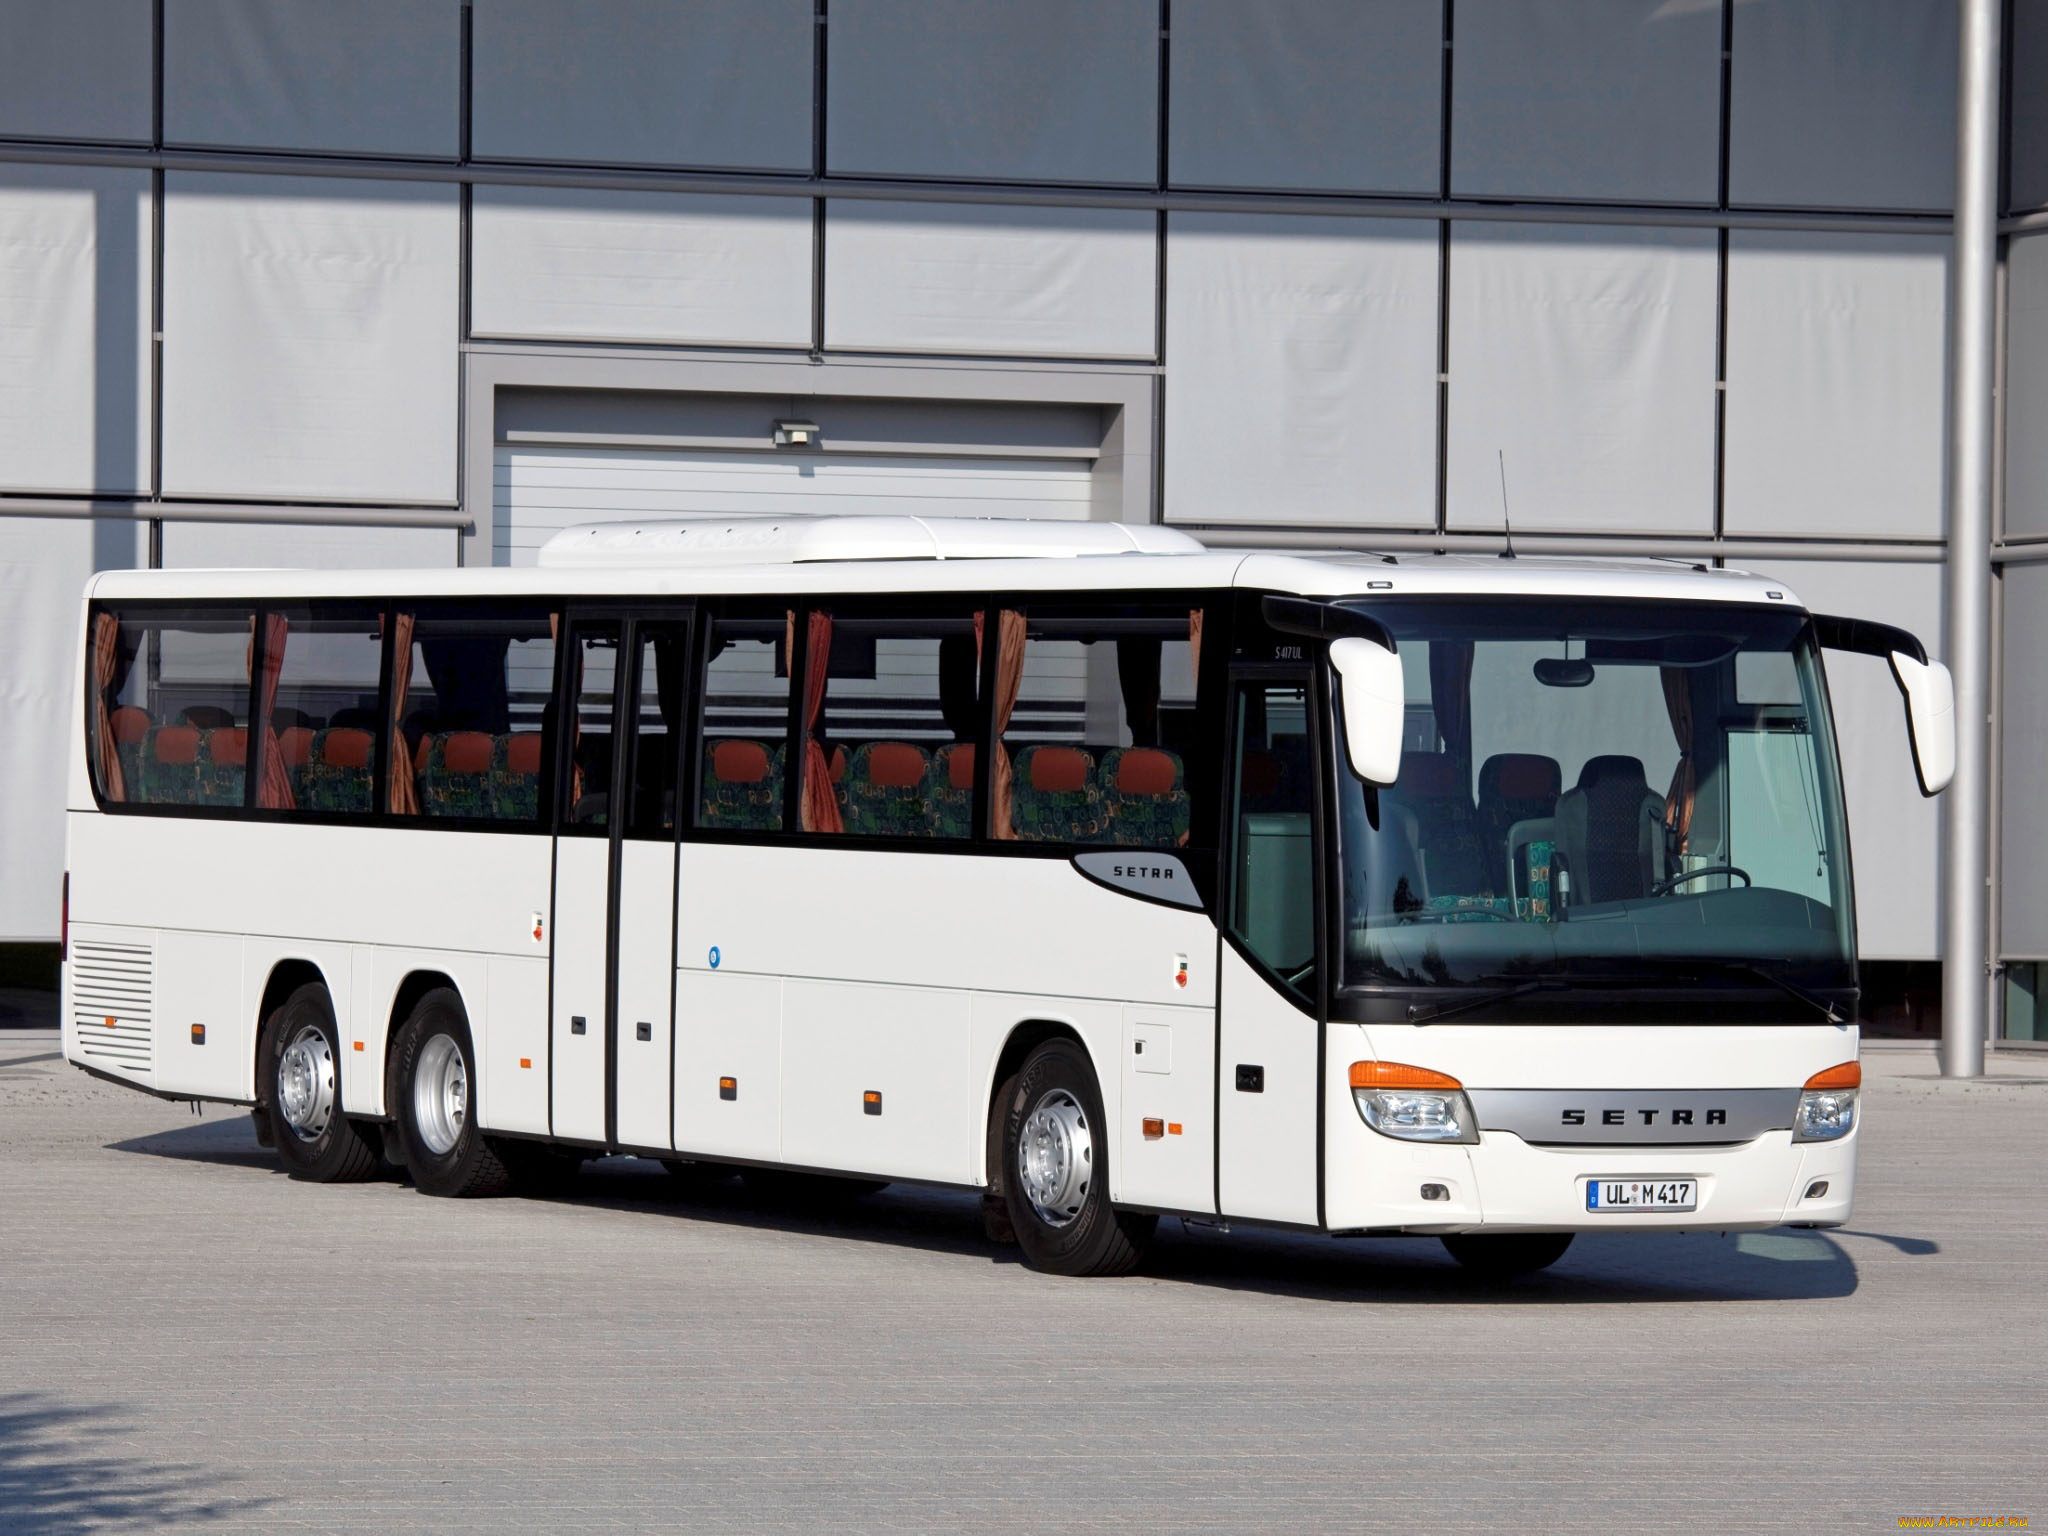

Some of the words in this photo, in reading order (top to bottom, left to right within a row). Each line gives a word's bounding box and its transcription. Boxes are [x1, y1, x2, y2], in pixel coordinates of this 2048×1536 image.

[1113, 866, 1174, 879] SETRA
[1561, 1109, 1727, 1125] SETRA
[1606, 1184, 1630, 1204] UL
[1642, 1184, 1654, 1204] M
[1657, 1183, 1690, 1204] 417
